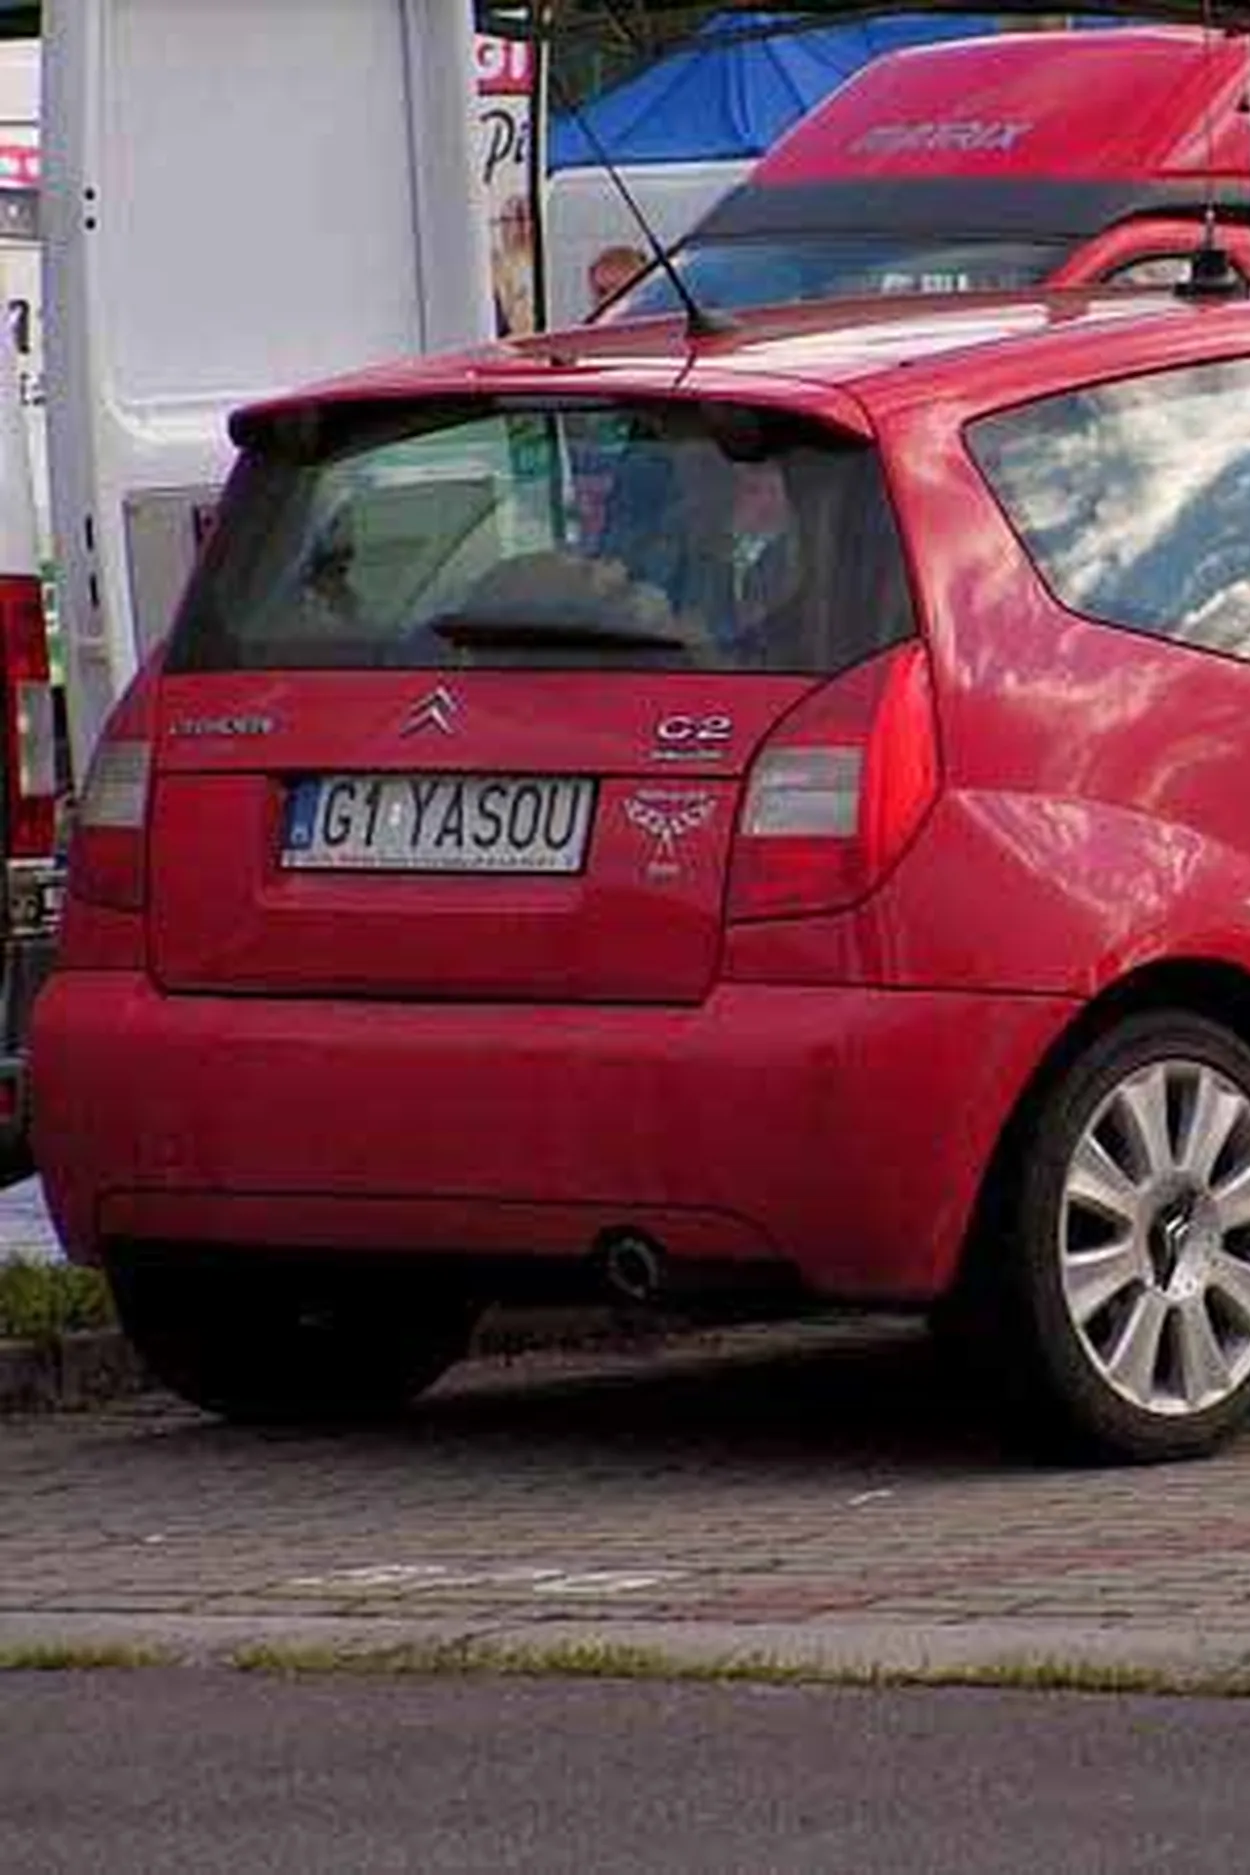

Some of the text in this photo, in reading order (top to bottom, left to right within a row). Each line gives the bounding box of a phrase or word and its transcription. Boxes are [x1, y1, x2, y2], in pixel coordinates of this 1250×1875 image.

[658, 715, 732, 740] C2
[321, 783, 381, 847] G1
[408, 780, 581, 850] YASOU
